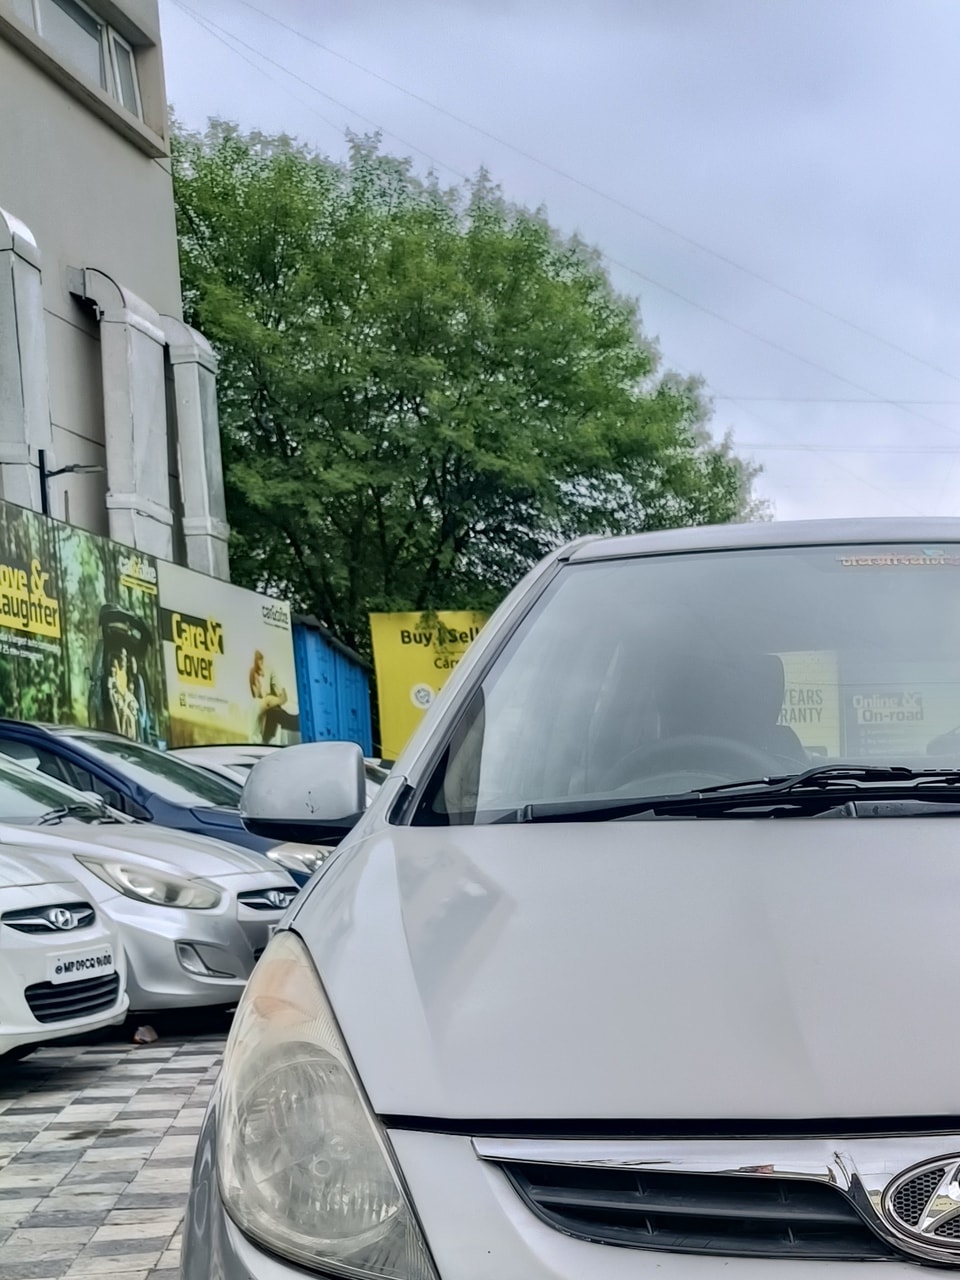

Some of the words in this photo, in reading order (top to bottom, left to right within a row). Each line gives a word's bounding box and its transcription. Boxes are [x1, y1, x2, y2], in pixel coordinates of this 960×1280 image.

[0, 593, 58, 628] aughter
[171, 612, 206, 650] Care
[401, 629, 432, 647] Buy
[175, 645, 213, 681] Cover
[863, 710, 924, 722] On-road
